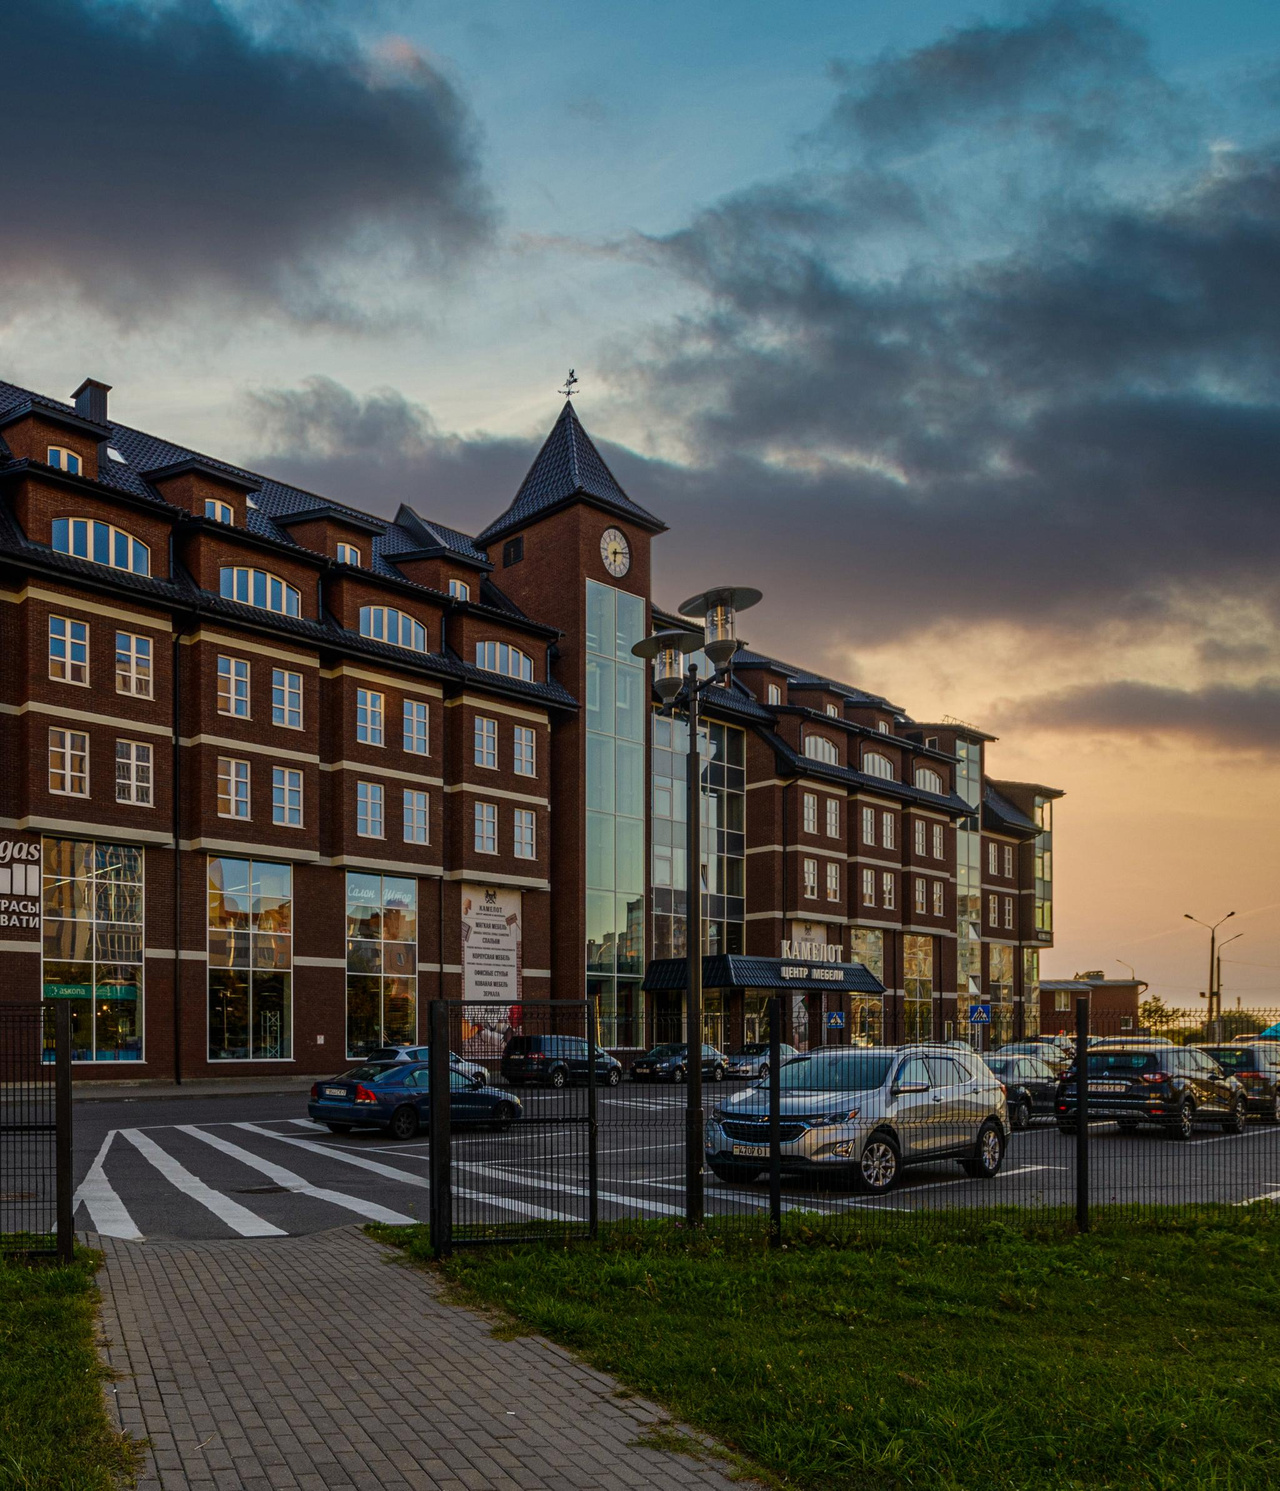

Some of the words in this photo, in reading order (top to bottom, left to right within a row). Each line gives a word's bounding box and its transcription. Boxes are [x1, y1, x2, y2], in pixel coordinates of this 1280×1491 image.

[348, 884, 376, 898] Салон
[382, 889, 412, 903] Штор
[479, 905, 502, 913] КАМЕЛОТ
[781, 940, 843, 962] КАМЕЛОТ
[781, 967, 808, 979] ЦЕНТР
[812, 969, 843, 980] МЕБЕЛИ
[59, 987, 86, 995] askona
[483, 990, 500, 998] ЗЕРКАЛА
